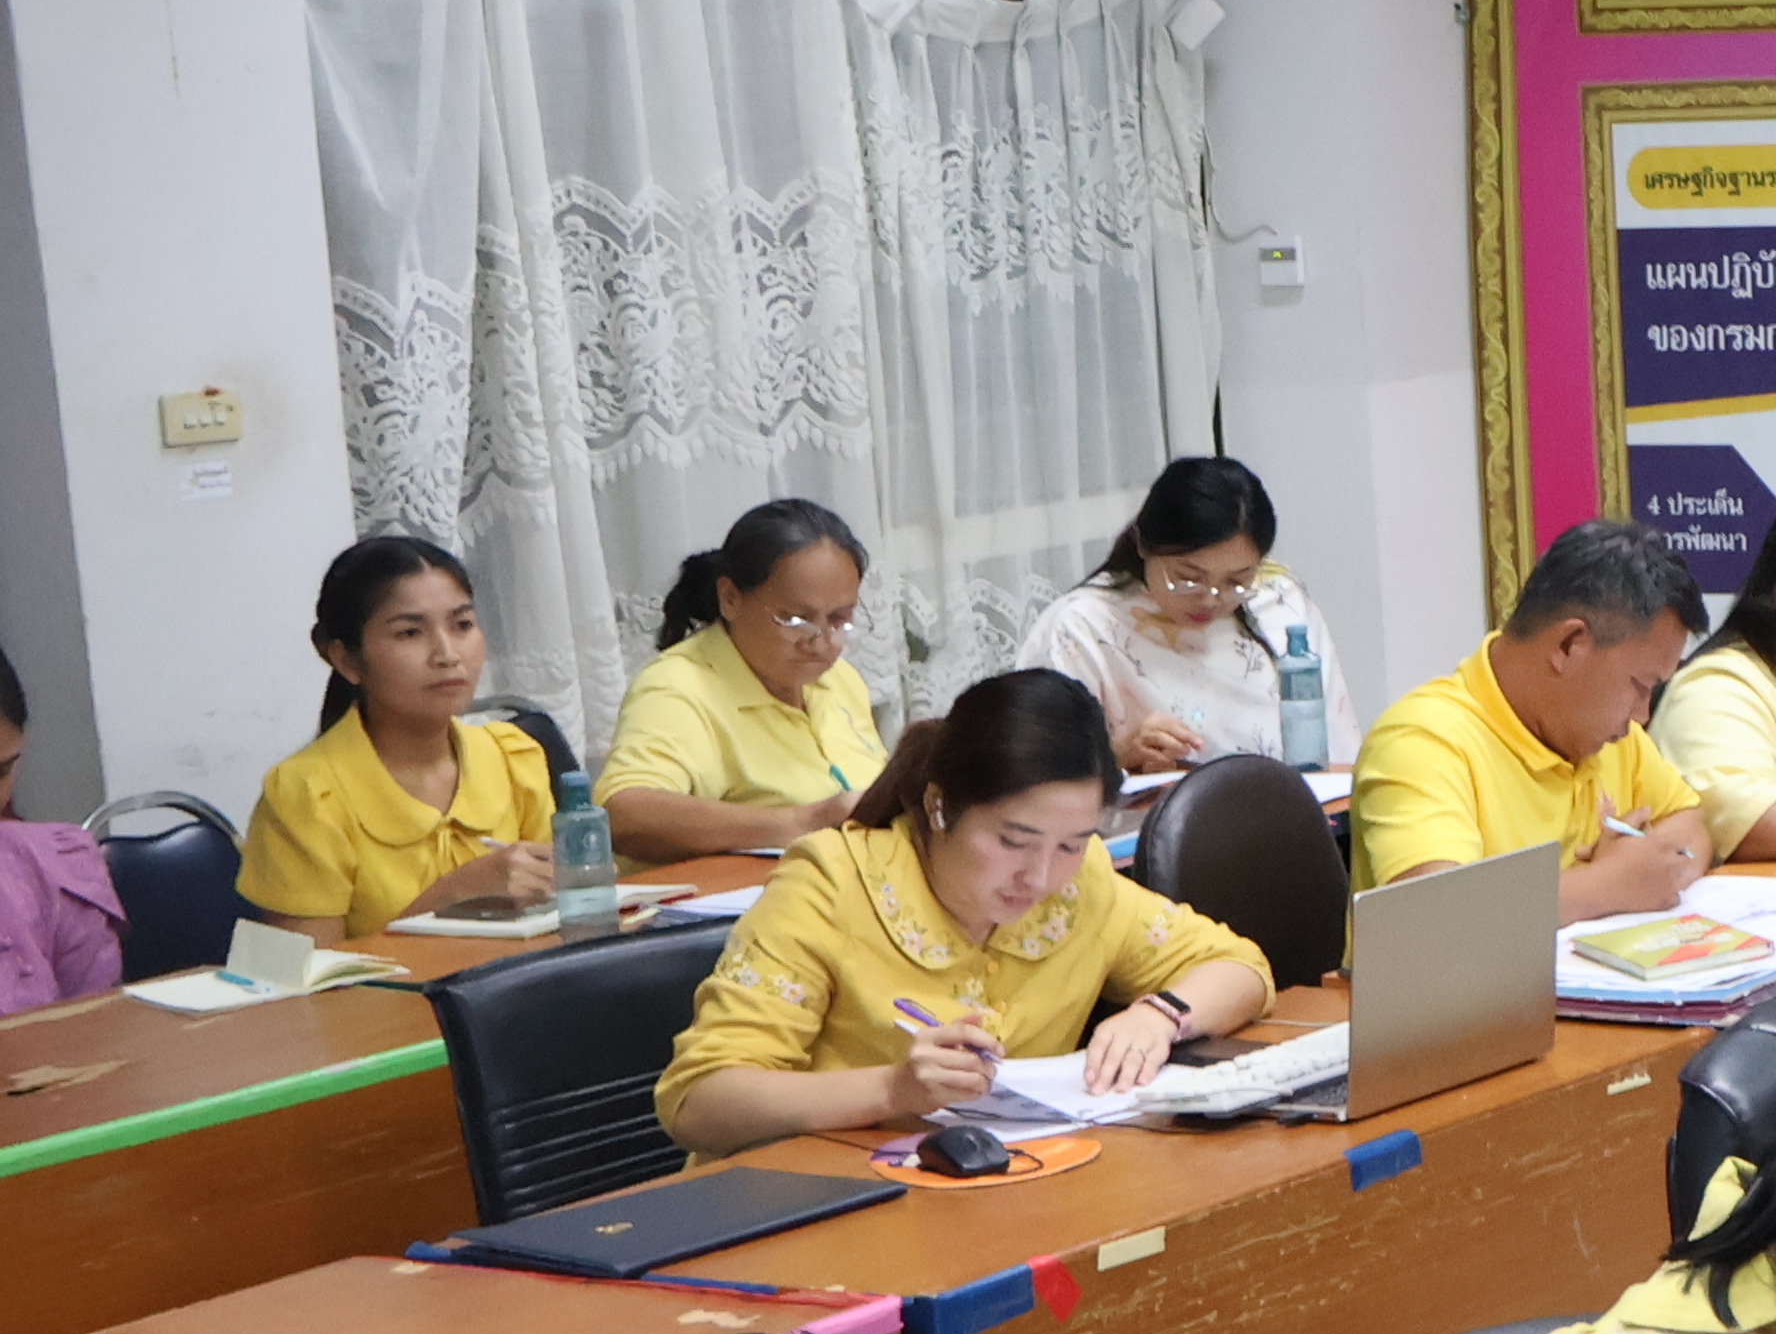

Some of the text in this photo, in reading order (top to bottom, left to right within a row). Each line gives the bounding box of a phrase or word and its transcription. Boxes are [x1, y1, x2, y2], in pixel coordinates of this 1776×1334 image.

[1647, 487, 1744, 516] 4 ประเด็น
[1663, 524, 1747, 552] ารพัฒนา
